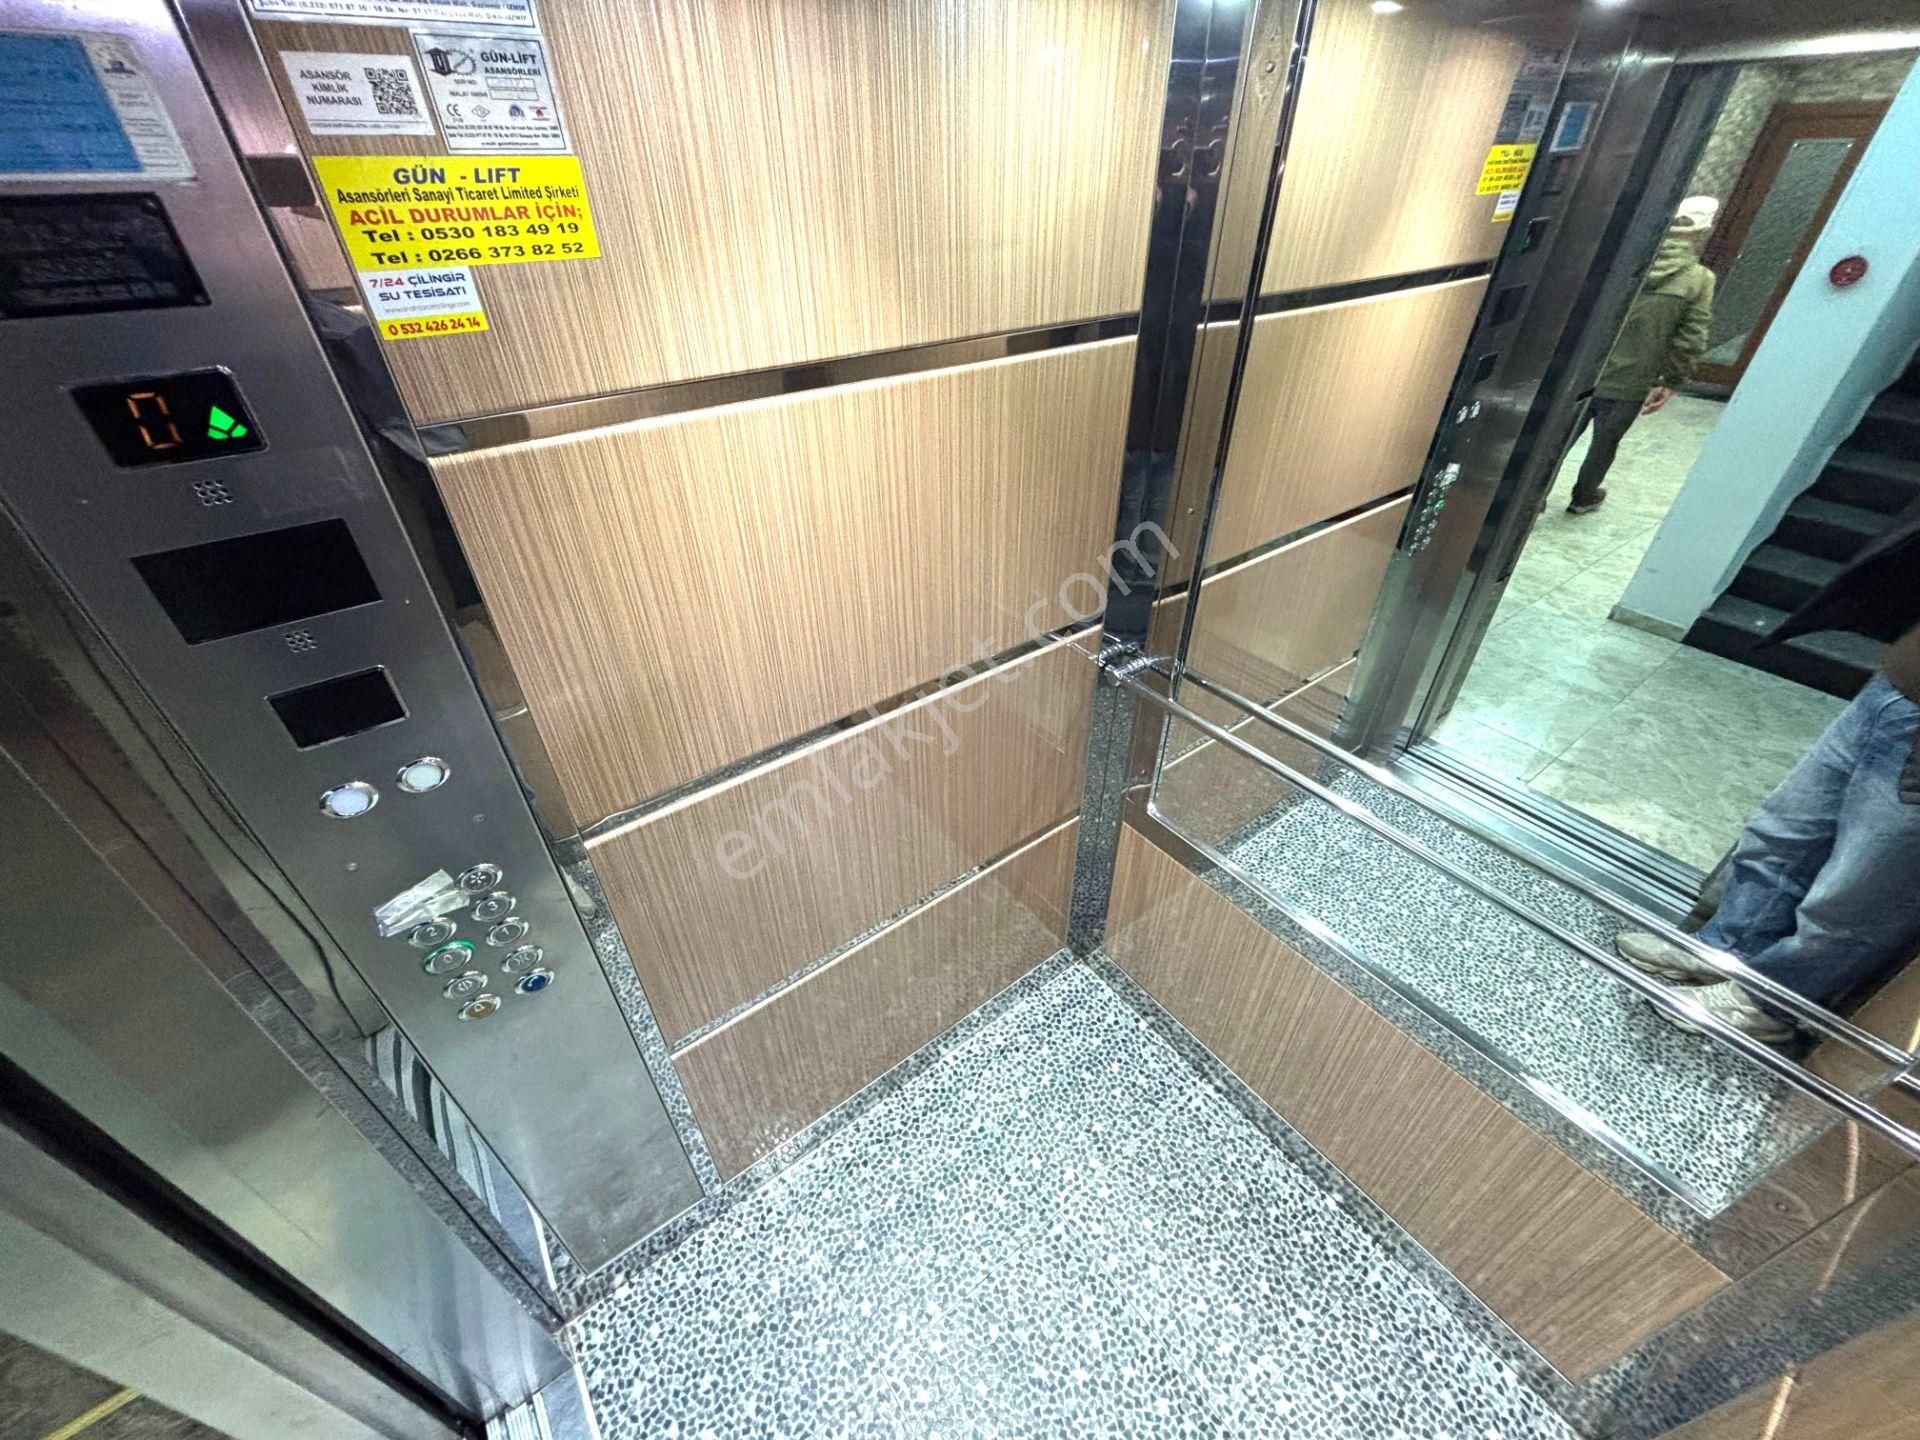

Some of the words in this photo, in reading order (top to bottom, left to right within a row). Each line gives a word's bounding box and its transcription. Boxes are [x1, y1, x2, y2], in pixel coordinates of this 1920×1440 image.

[300, 69, 352, 81] ASANSÖR
[311, 82, 349, 93] KİMLİK
[306, 95, 362, 106] NUMARASI
[393, 164, 446, 185] GÜN
[474, 167, 520, 184] LIFT
[336, 187, 411, 203] Asansörleri
[412, 186, 454, 205] Sanayi
[455, 186, 499, 201] Ticaret
[501, 185, 543, 200] Limited
[544, 184, 579, 202] Şirketi
[350, 205, 405, 226] ACİL
[408, 205, 531, 224] DURUMLAR
[535, 202, 582, 222] İÇİN;
[362, 229, 401, 243] Tel
[421, 226, 475, 241] 0530
[482, 224, 519, 238] 183
[526, 223, 550, 235] 49
[556, 222, 579, 234] 19
[370, 251, 408, 265] Tel
[428, 247, 482, 262] 0266
[488, 245, 526, 258] 373
[531, 243, 555, 256] 82
[561, 242, 584, 254] 52
[369, 277, 405, 289] 7/24
[407, 271, 466, 286] ÇİLİNGİR
[379, 292, 401, 302] SU
[403, 286, 467, 300] TESİSATI
[388, 324, 399, 336] 0
[400, 322, 423, 335] 532
[426, 321, 448, 332] 426
[450, 318, 465, 330] 24
[467, 316, 481, 328] 14
[127, 392, 183, 449] 0
[487, 901, 498, 911] 3
[426, 926, 438, 937] 2
